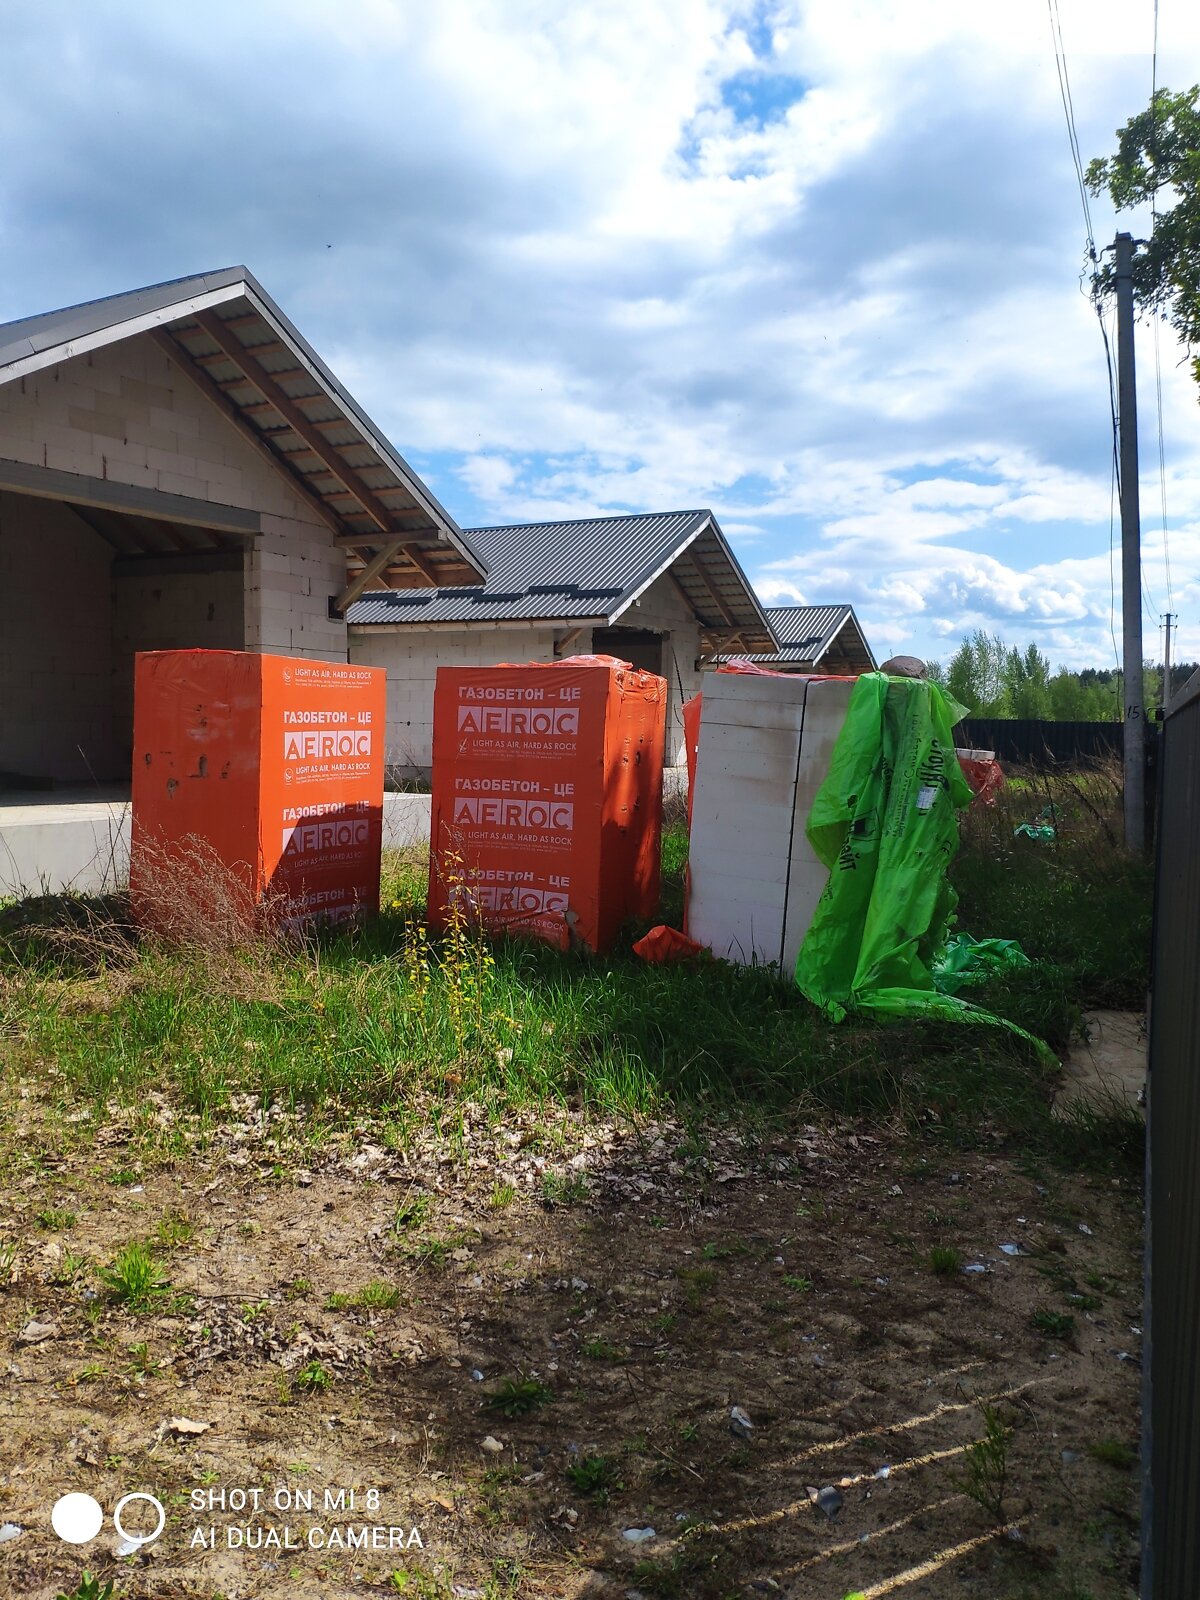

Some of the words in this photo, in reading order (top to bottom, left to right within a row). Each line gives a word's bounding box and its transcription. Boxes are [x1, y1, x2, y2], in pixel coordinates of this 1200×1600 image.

[294, 668, 311, 677] LIGHT
[311, 669, 320, 677] AS
[332, 671, 348, 679] HARD
[349, 671, 357, 679] AS
[458, 686, 544, 700] ГАЗОБЕТОН
[559, 687, 581, 702] ЦЕ
[283, 711, 348, 724] ГАЗОБЕТОН
[357, 711, 372, 725] ЦЕ
[457, 705, 580, 735] AEROC
[1127, 705, 1140, 720] 15
[284, 730, 372, 760] AEROC
[473, 739, 494, 747] LIGHT
[495, 740, 505, 748] AS
[523, 741, 542, 750] HARD
[543, 742, 553, 750] AS
[554, 742, 577, 751] ROCK
[454, 778, 540, 793] ГАЗОБЕТОН
[554, 783, 575, 797] ЦЕ
[282, 802, 346, 821] ГАЗОБЕТОН
[356, 800, 370, 814] ЦЕ
[453, 797, 574, 831] AEROC
[282, 819, 369, 855] AEROC
[468, 831, 489, 840] LIGHT
[489, 832, 500, 840] AS
[517, 833, 538, 842] HARD
[539, 835, 549, 843] AS
[550, 836, 572, 846] ROCK
[549, 874, 571, 888] ЦЕ
